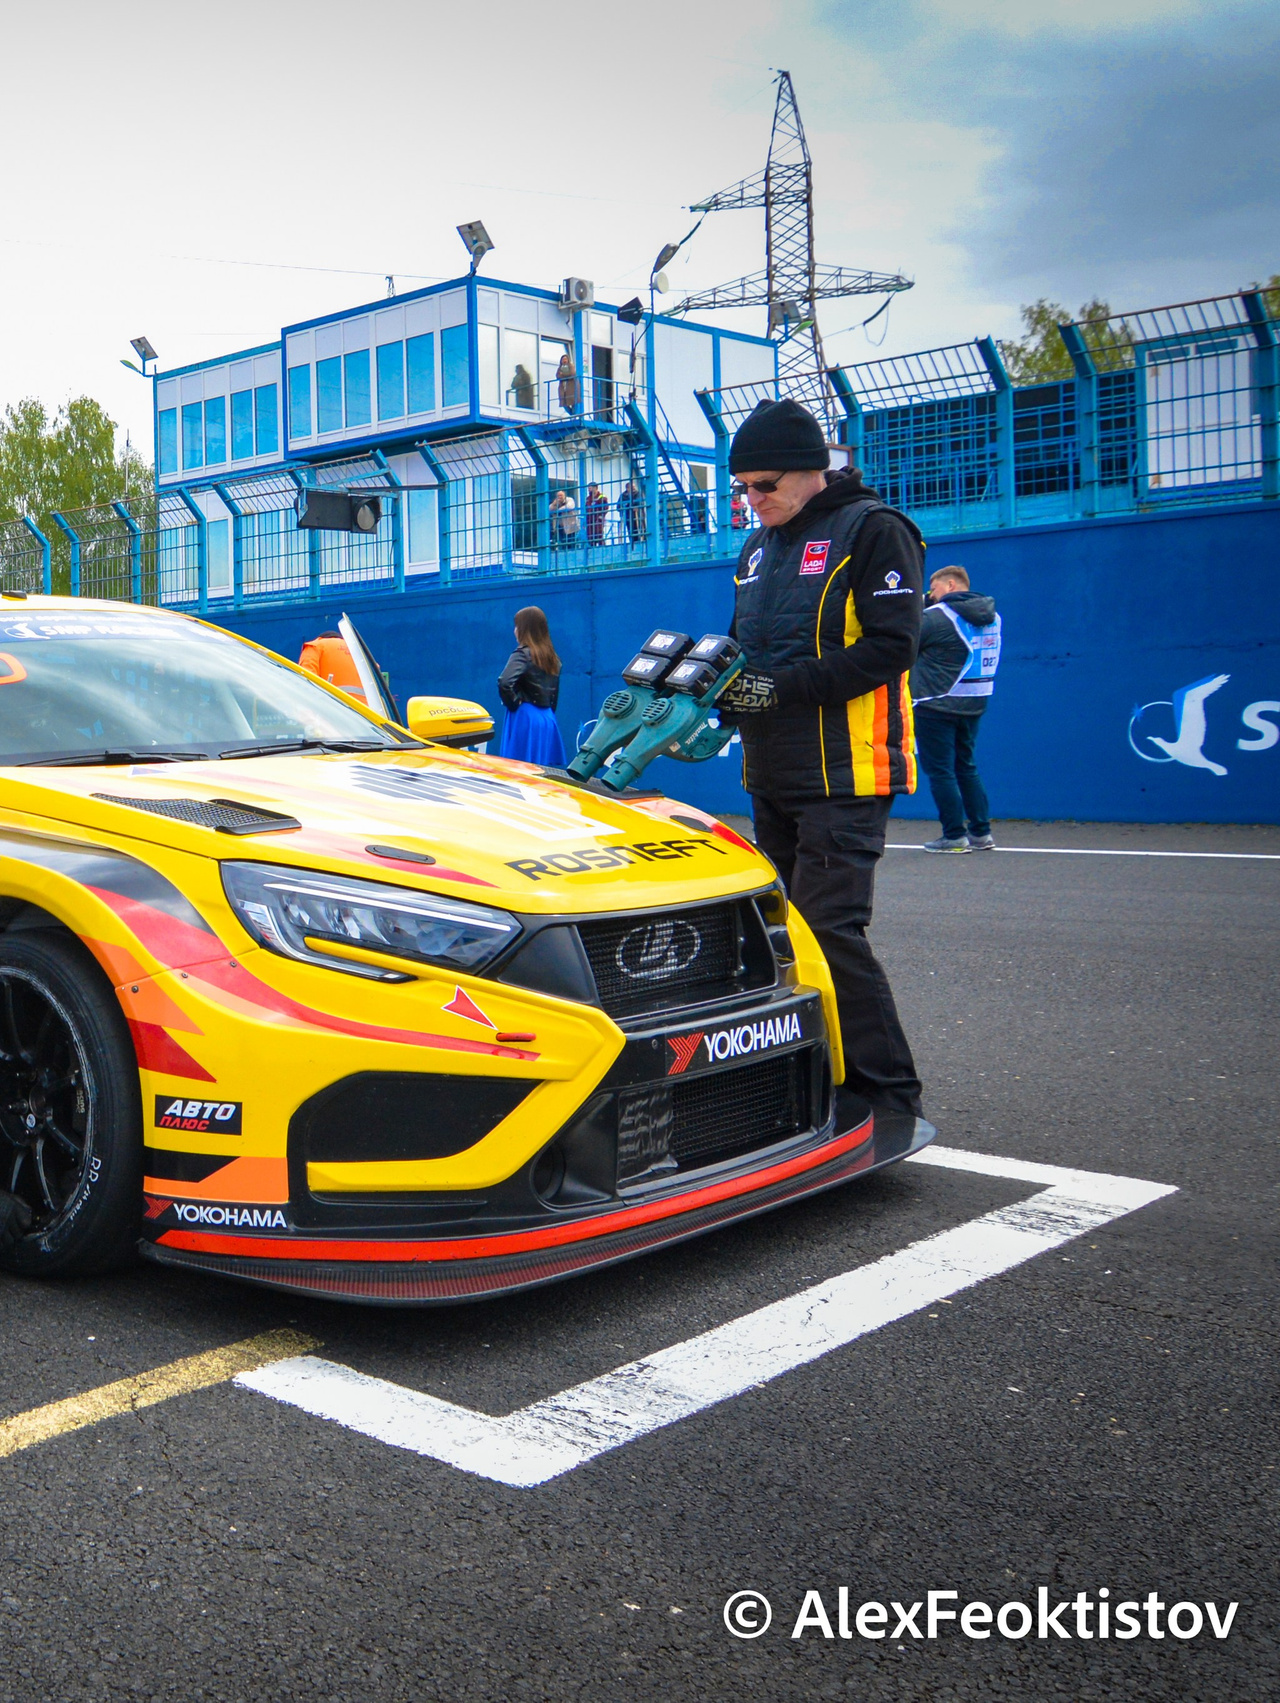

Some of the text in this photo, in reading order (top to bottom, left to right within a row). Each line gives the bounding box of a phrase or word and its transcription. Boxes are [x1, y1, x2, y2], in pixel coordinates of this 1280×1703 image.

[804, 560, 823, 568] LADA
[504, 839, 728, 881] ROSNEFT
[704, 1012, 802, 1063] YOKOHAMA
[164, 1099, 237, 1121] АВТО
[159, 1115, 210, 1131] ПЛЮС
[173, 1202, 287, 1229] YOKOHAMA
